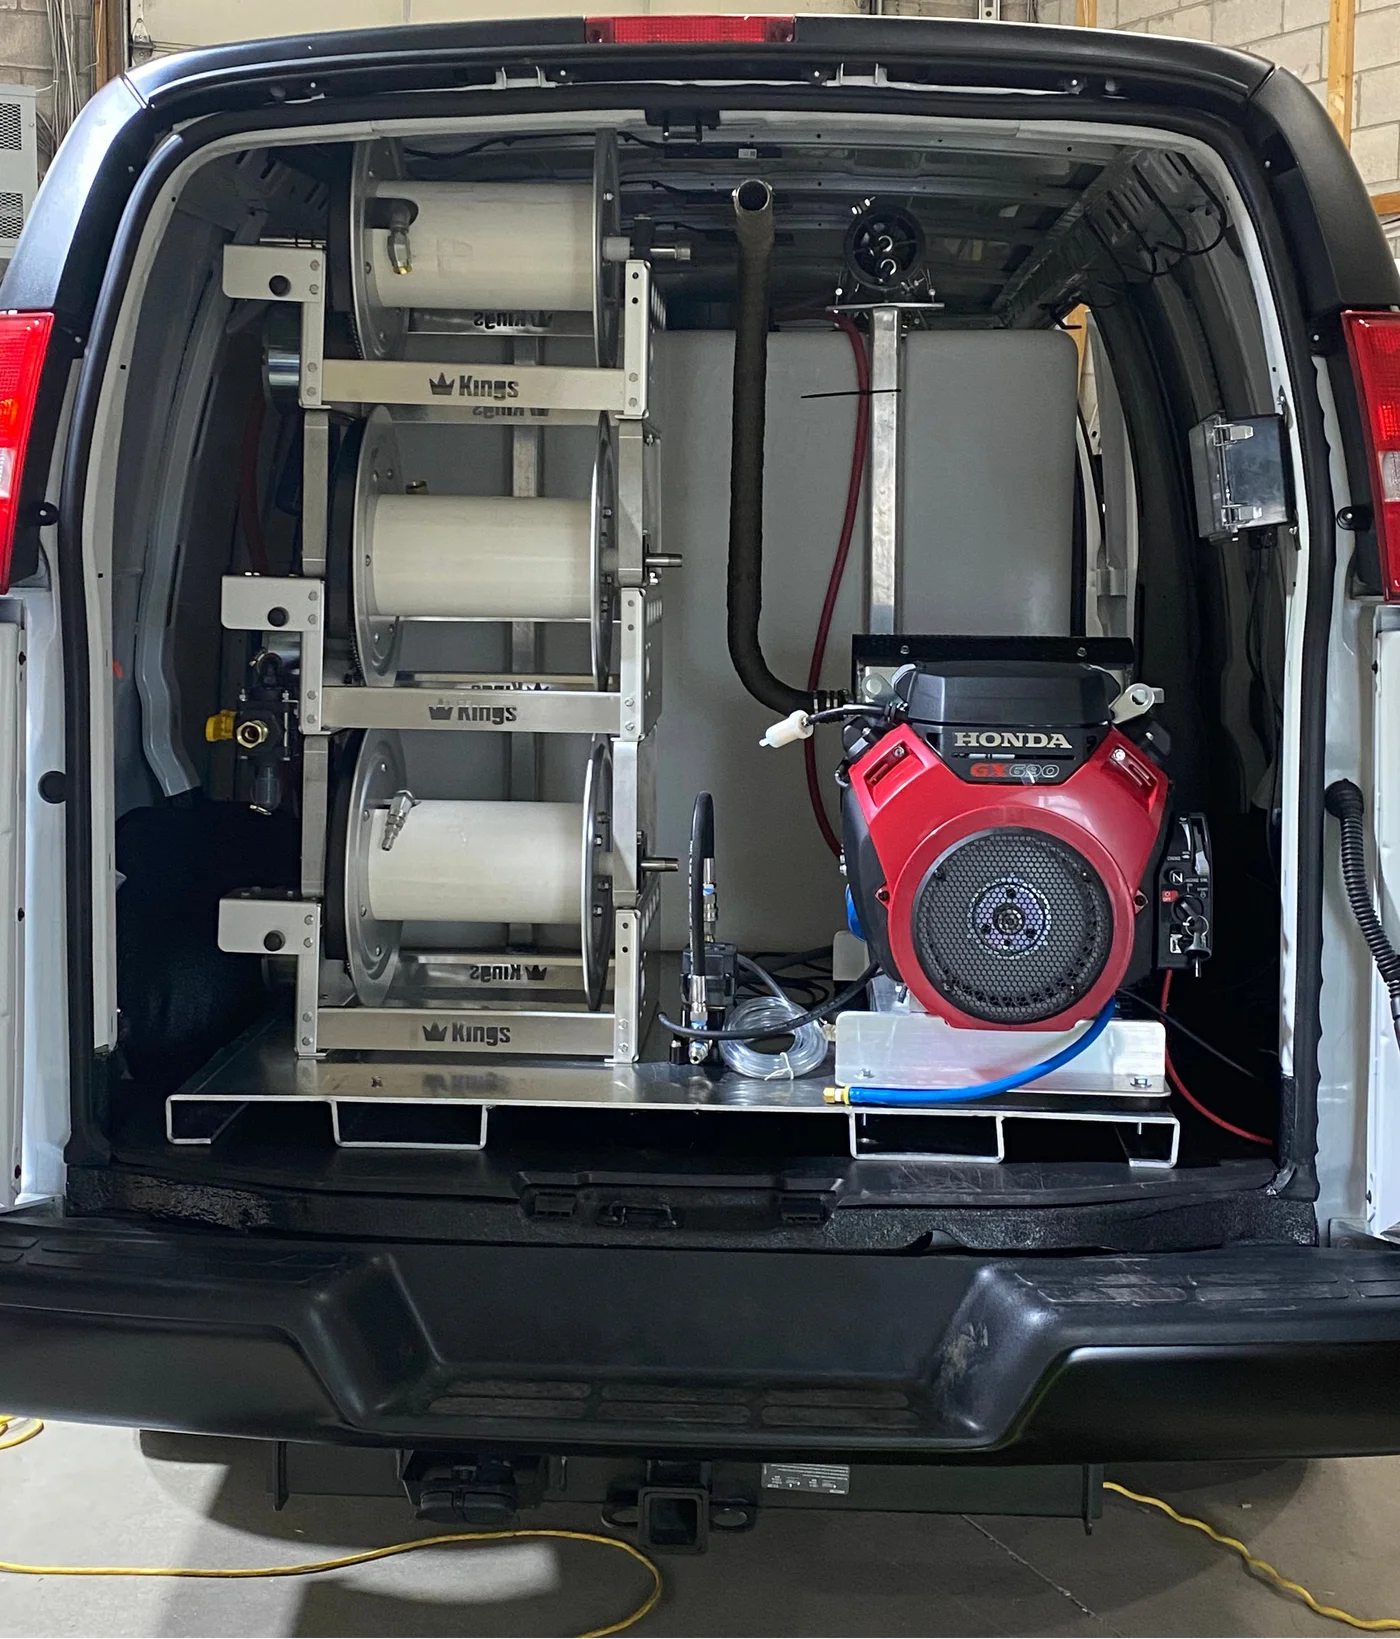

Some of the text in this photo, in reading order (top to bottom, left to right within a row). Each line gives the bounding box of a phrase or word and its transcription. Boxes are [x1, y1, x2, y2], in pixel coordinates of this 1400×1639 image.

[459, 375, 519, 401] Kings
[458, 701, 517, 725] Kings
[953, 731, 1073, 749] HONDA
[970, 762, 1060, 778] GX690
[451, 1022, 511, 1047] Kings
